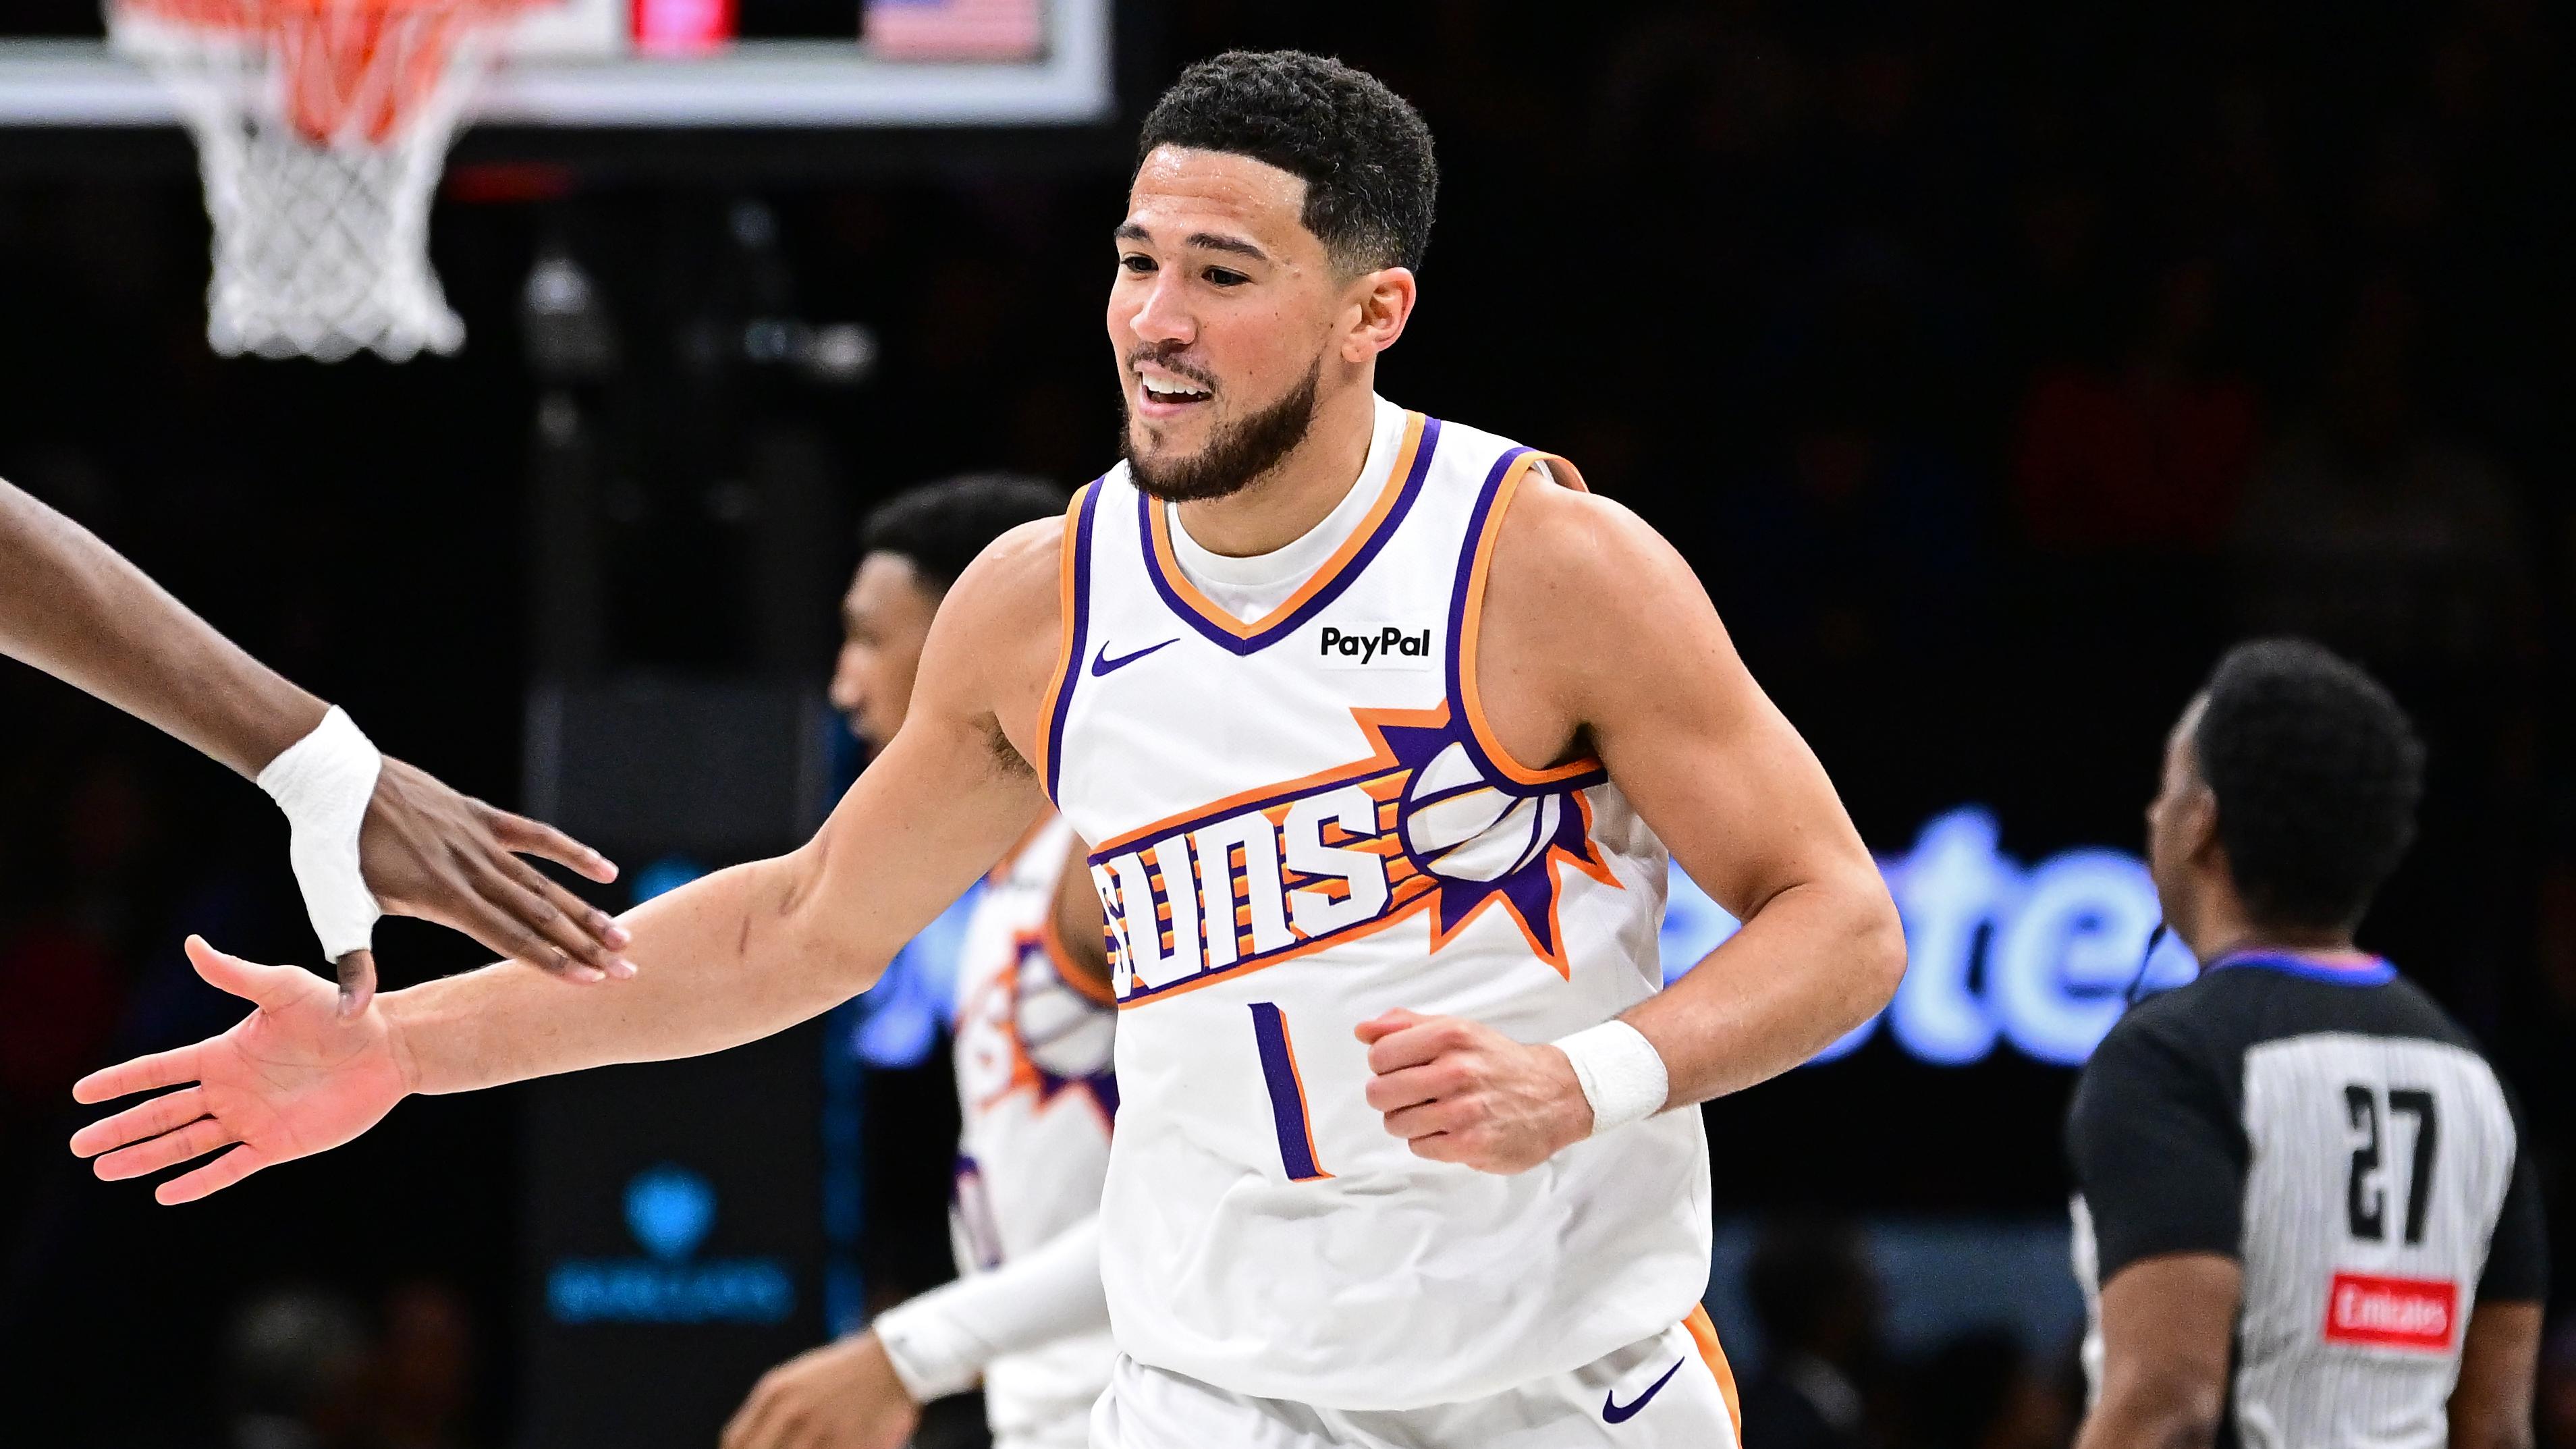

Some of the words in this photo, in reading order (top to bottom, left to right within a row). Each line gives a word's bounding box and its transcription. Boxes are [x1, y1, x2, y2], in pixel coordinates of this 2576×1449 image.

[1321, 626, 1430, 665] PayPal
[1090, 784, 1389, 999] SUNS
[1247, 1002, 1336, 1182] 1
[2344, 1084, 2436, 1245] 27
